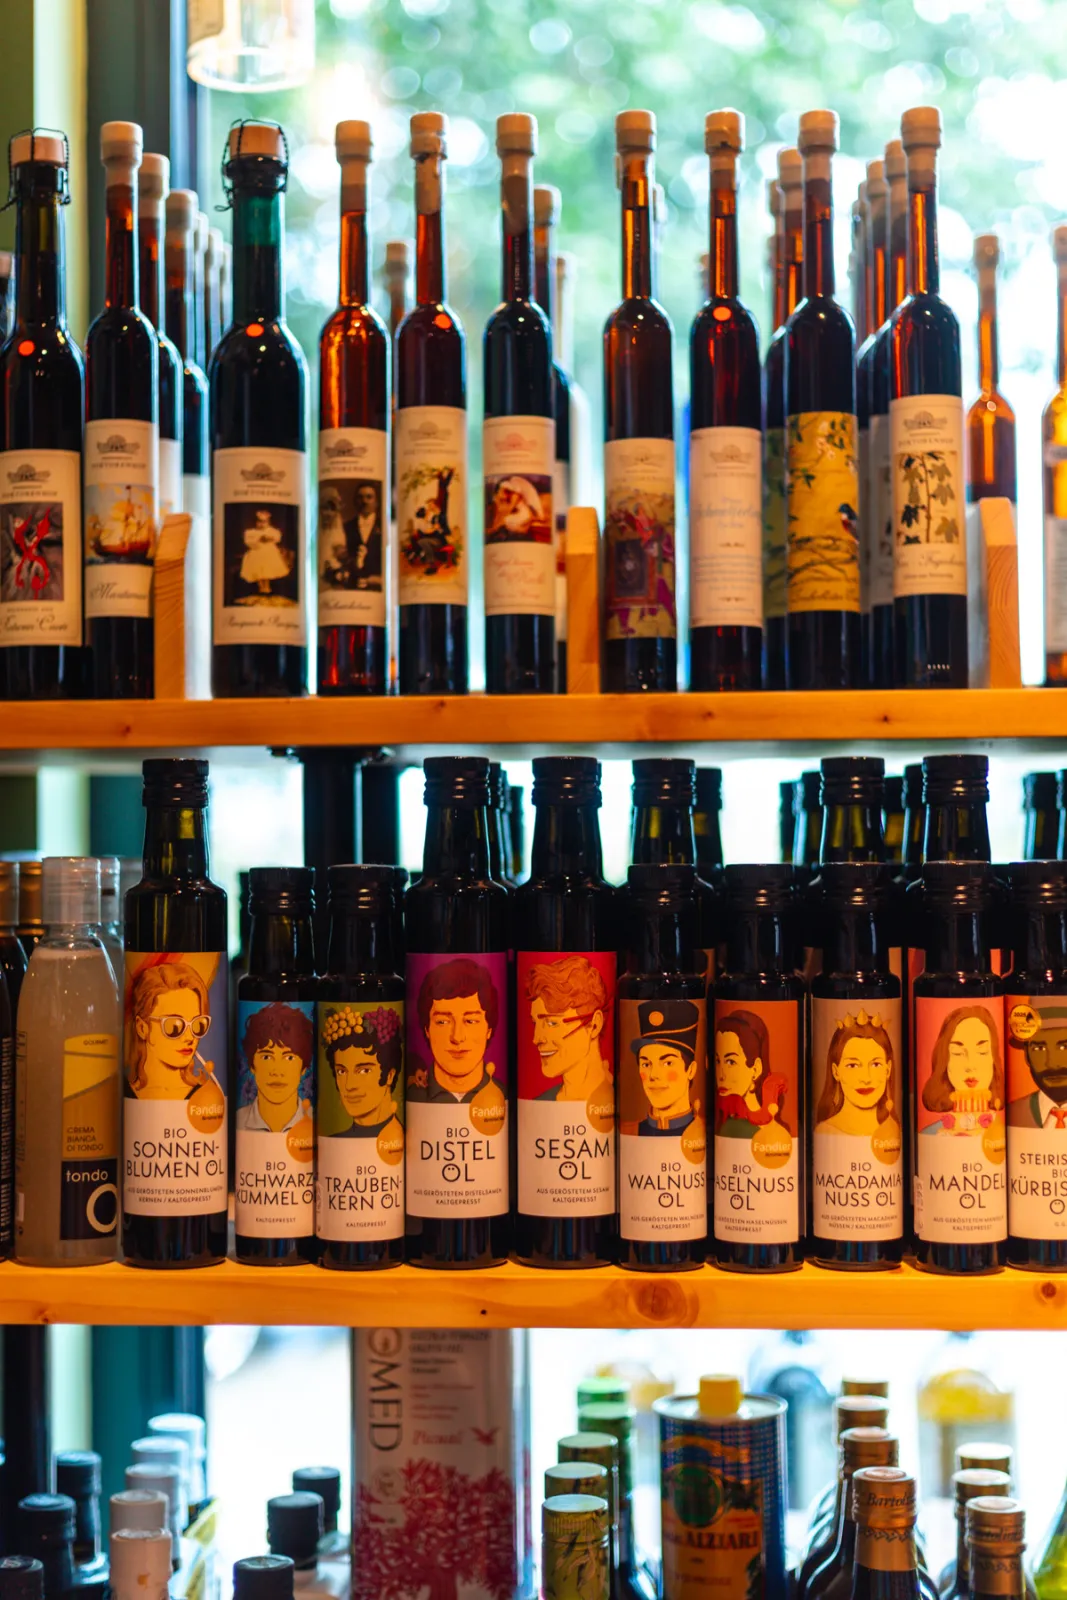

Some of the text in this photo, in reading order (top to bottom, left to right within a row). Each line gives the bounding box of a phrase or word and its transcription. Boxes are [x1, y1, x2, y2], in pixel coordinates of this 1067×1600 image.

[67, 1126, 95, 1134] CREMA
[164, 1128, 187, 1138] BIO
[446, 1127, 470, 1138] BIO
[563, 1124, 587, 1136] BIO
[67, 1135, 97, 1143] BIANCA
[67, 1143, 104, 1152] DI TONDO
[133, 1141, 219, 1158] SONNEN-
[420, 1140, 496, 1161] DISTEL
[534, 1137, 610, 1159] SESAM
[753, 1142, 791, 1153] Fandler
[126, 1159, 224, 1178] BLUMEN ÖL
[266, 1161, 287, 1171] BIO
[356, 1165, 377, 1175] BIO
[558, 1161, 592, 1181] ÖL
[661, 1162, 682, 1172] BIO
[732, 1164, 752, 1175] BIO
[850, 1162, 872, 1172] BIO
[962, 1162, 983, 1173] BIO
[66, 1169, 108, 1182] tondo
[441, 1163, 475, 1183] ÖL
[628, 1172, 705, 1190] WALNUSS
[715, 1175, 794, 1193] ASELNUSS
[929, 1173, 1005, 1191] MANDEL
[136, 1187, 174, 1195] GERÖSTETEN
[423, 1189, 463, 1197] GERÖSTETEN
[168, 1195, 212, 1203] KALTGEPRESST
[328, 1194, 374, 1211] KERN
[381, 1193, 400, 1209] ÖL
[435, 1198, 481, 1206] KALTGEPRESST
[552, 1196, 597, 1204] KALTGEPRESST
[658, 1192, 685, 1208] ÖL
[730, 1194, 755, 1211] ÖL
[825, 1190, 896, 1207] NUSS ÖL
[959, 1193, 986, 1209] ÖL
[346, 1220, 387, 1228] KALTGEPRESST
[725, 1225, 762, 1233] KALTGEPRESST
